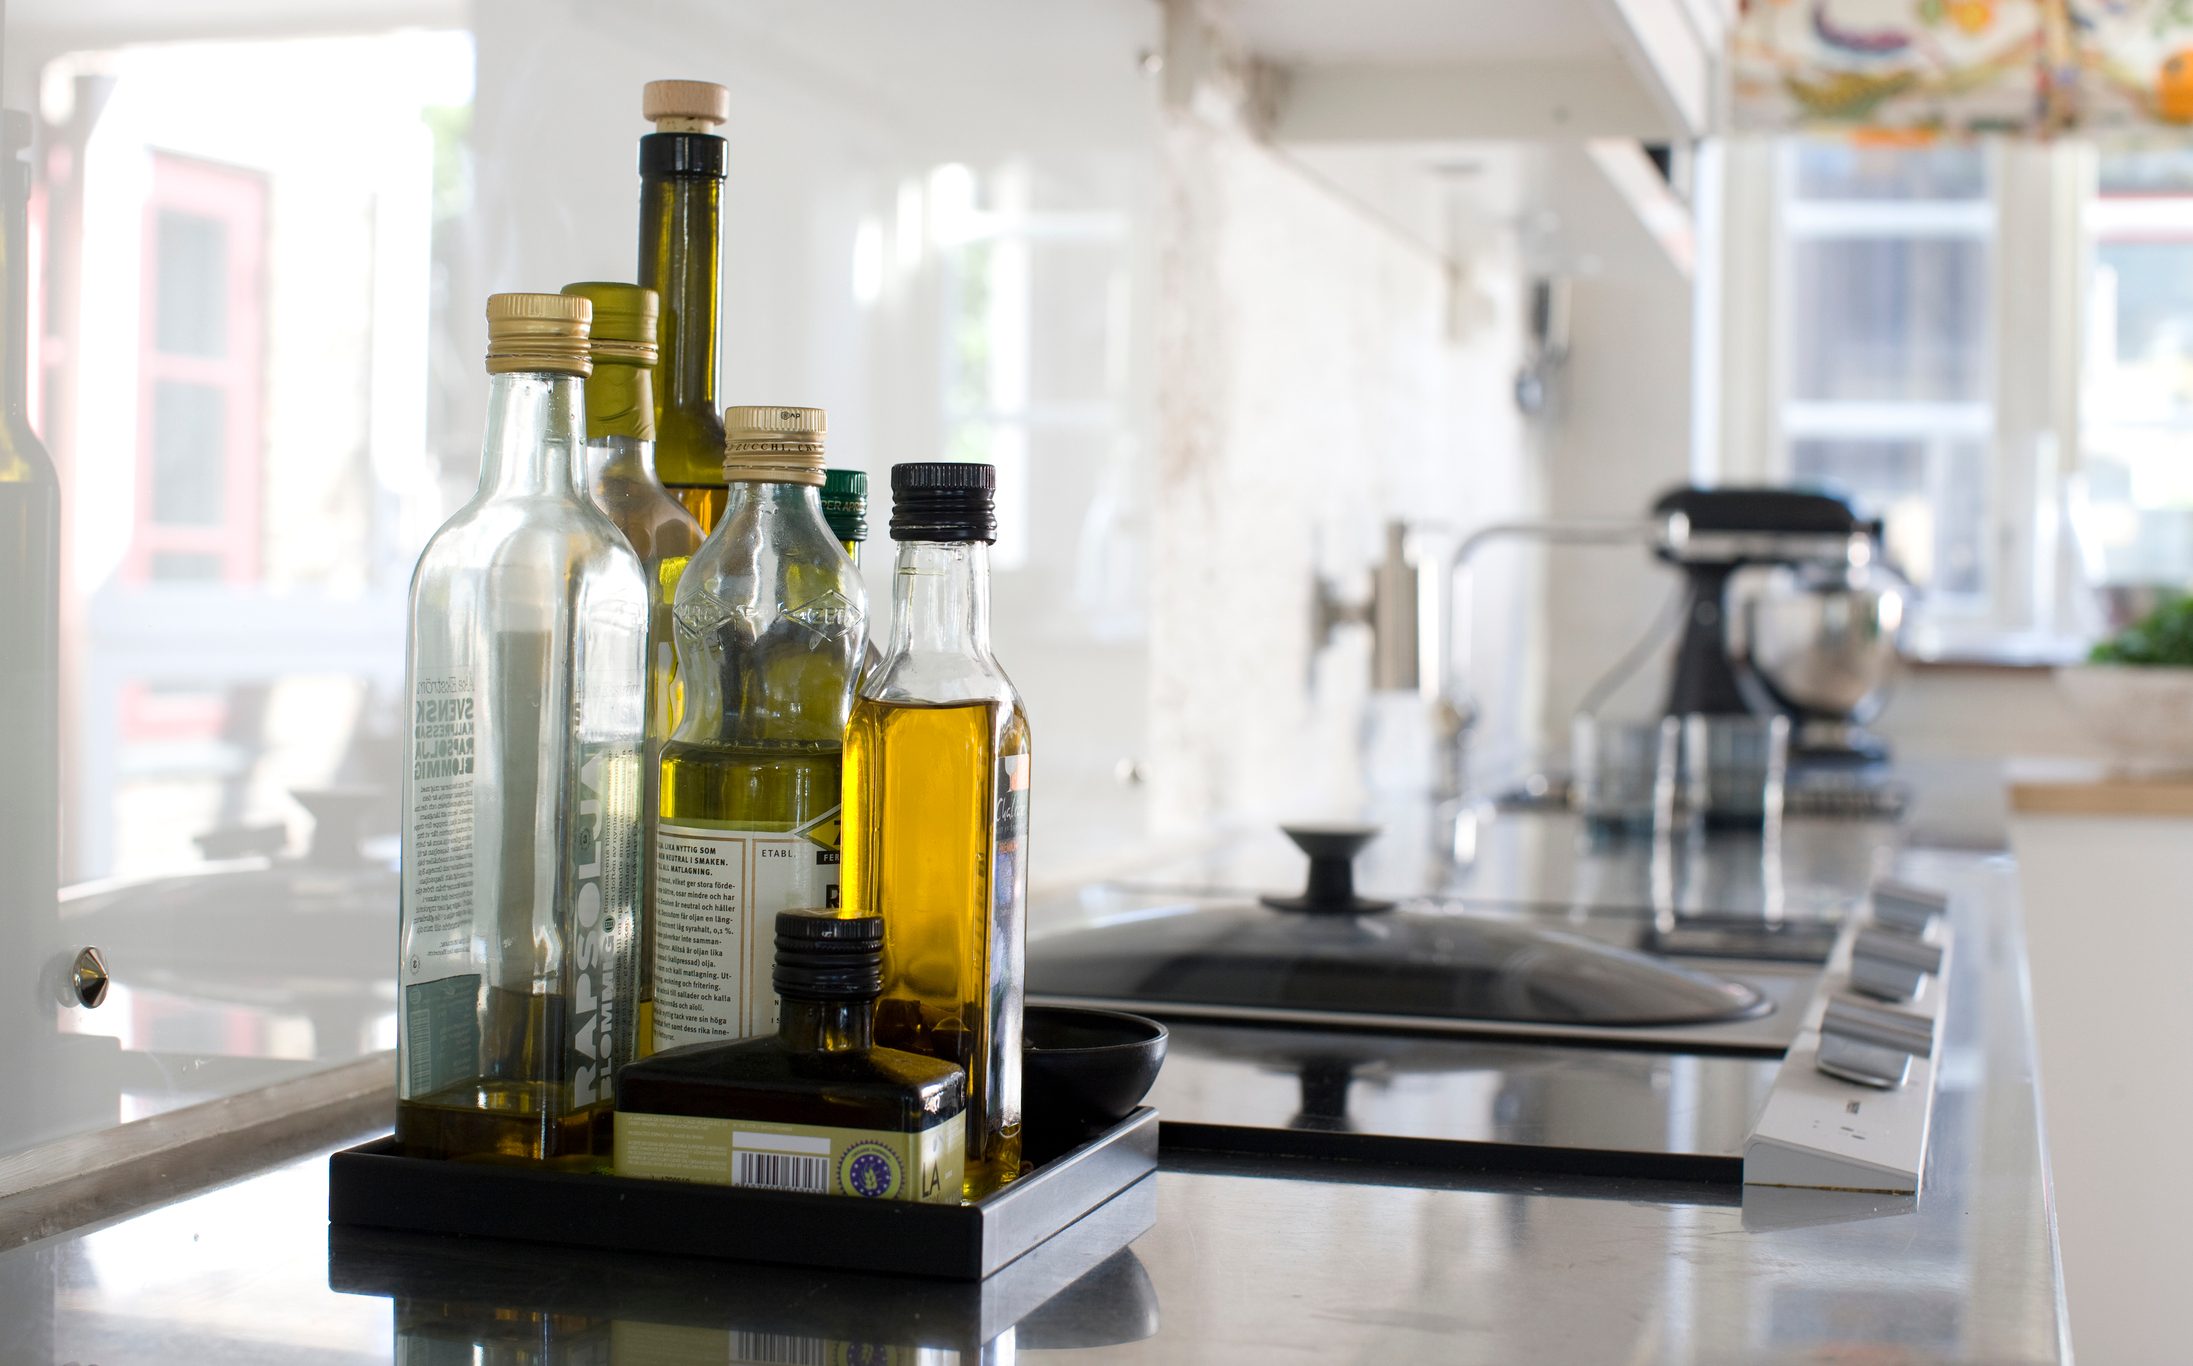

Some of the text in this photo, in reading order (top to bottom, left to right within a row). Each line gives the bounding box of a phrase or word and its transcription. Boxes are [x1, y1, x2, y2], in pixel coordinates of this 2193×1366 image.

[735, 442, 792, 452] ZUCCHI,
[676, 845, 698, 854] NYTTIG
[699, 847, 717, 856] SOM
[761, 849, 797, 859] ETABL.
[694, 857, 729, 867] SMAKEN.
[823, 853, 841, 862] FER
[671, 865, 713, 876] MATLAGNING.
[686, 881, 697, 889] ger
[697, 881, 714, 890] stora
[714, 881, 736, 890] förde-
[687, 891, 709, 900] mindre
[709, 893, 722, 901] och
[723, 893, 736, 901] har
[681, 901, 701, 911] neutral
[701, 903, 714, 912] och
[715, 904, 736, 913] håller
[688, 913, 705, 923] oljan
[573, 750, 602, 1108] RAPSOLJA
[685, 925, 712, 935] syrahalt,
[692, 937, 723, 946] samman-
[693, 948, 709, 958] oljan
[710, 949, 724, 957] lika
[701, 959, 716, 969] olja.
[683, 969, 720, 981] matlagning.
[721, 972, 732, 980] Ut-
[692, 980, 721, 992] fritering.
[677, 991, 700, 1000] sallader
[700, 993, 713, 1001] och
[713, 994, 732, 1003] kalla
[678, 1002, 689, 1010] och
[600, 934, 615, 1101] BLOMMIG
[699, 1015, 709, 1024] sin
[710, 1015, 727, 1026] höga
[684, 1025, 698, 1034] dess
[698, 1026, 711, 1035] rika
[711, 1027, 731, 1036] inne-
[922, 1159, 941, 1198] LA
